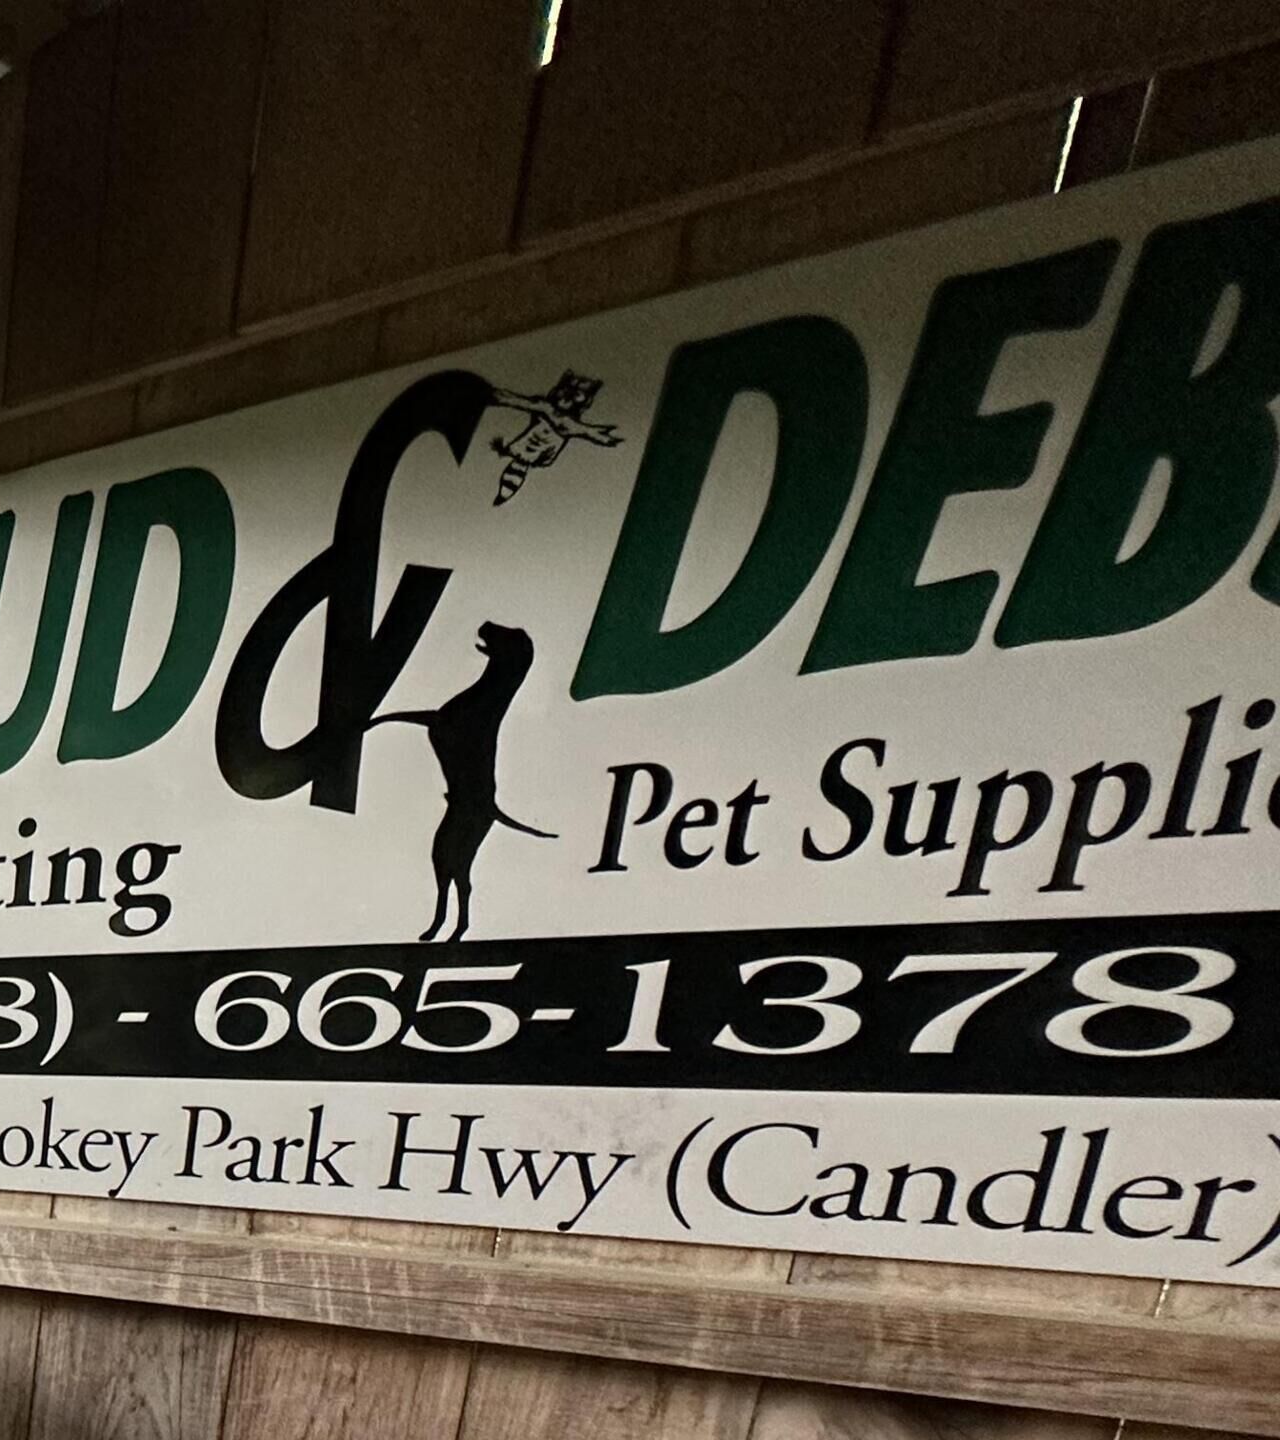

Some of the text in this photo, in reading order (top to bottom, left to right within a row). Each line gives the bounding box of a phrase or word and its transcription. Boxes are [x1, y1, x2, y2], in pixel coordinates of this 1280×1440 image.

[215, 369, 498, 815] &
[570, 198, 1280, 702] DEB
[588, 694, 1280, 898] Pet Suppli
[193, 945, 1237, 1058] 665-1378
[174, 1104, 354, 1188] Park
[378, 1110, 636, 1231] Hwy
